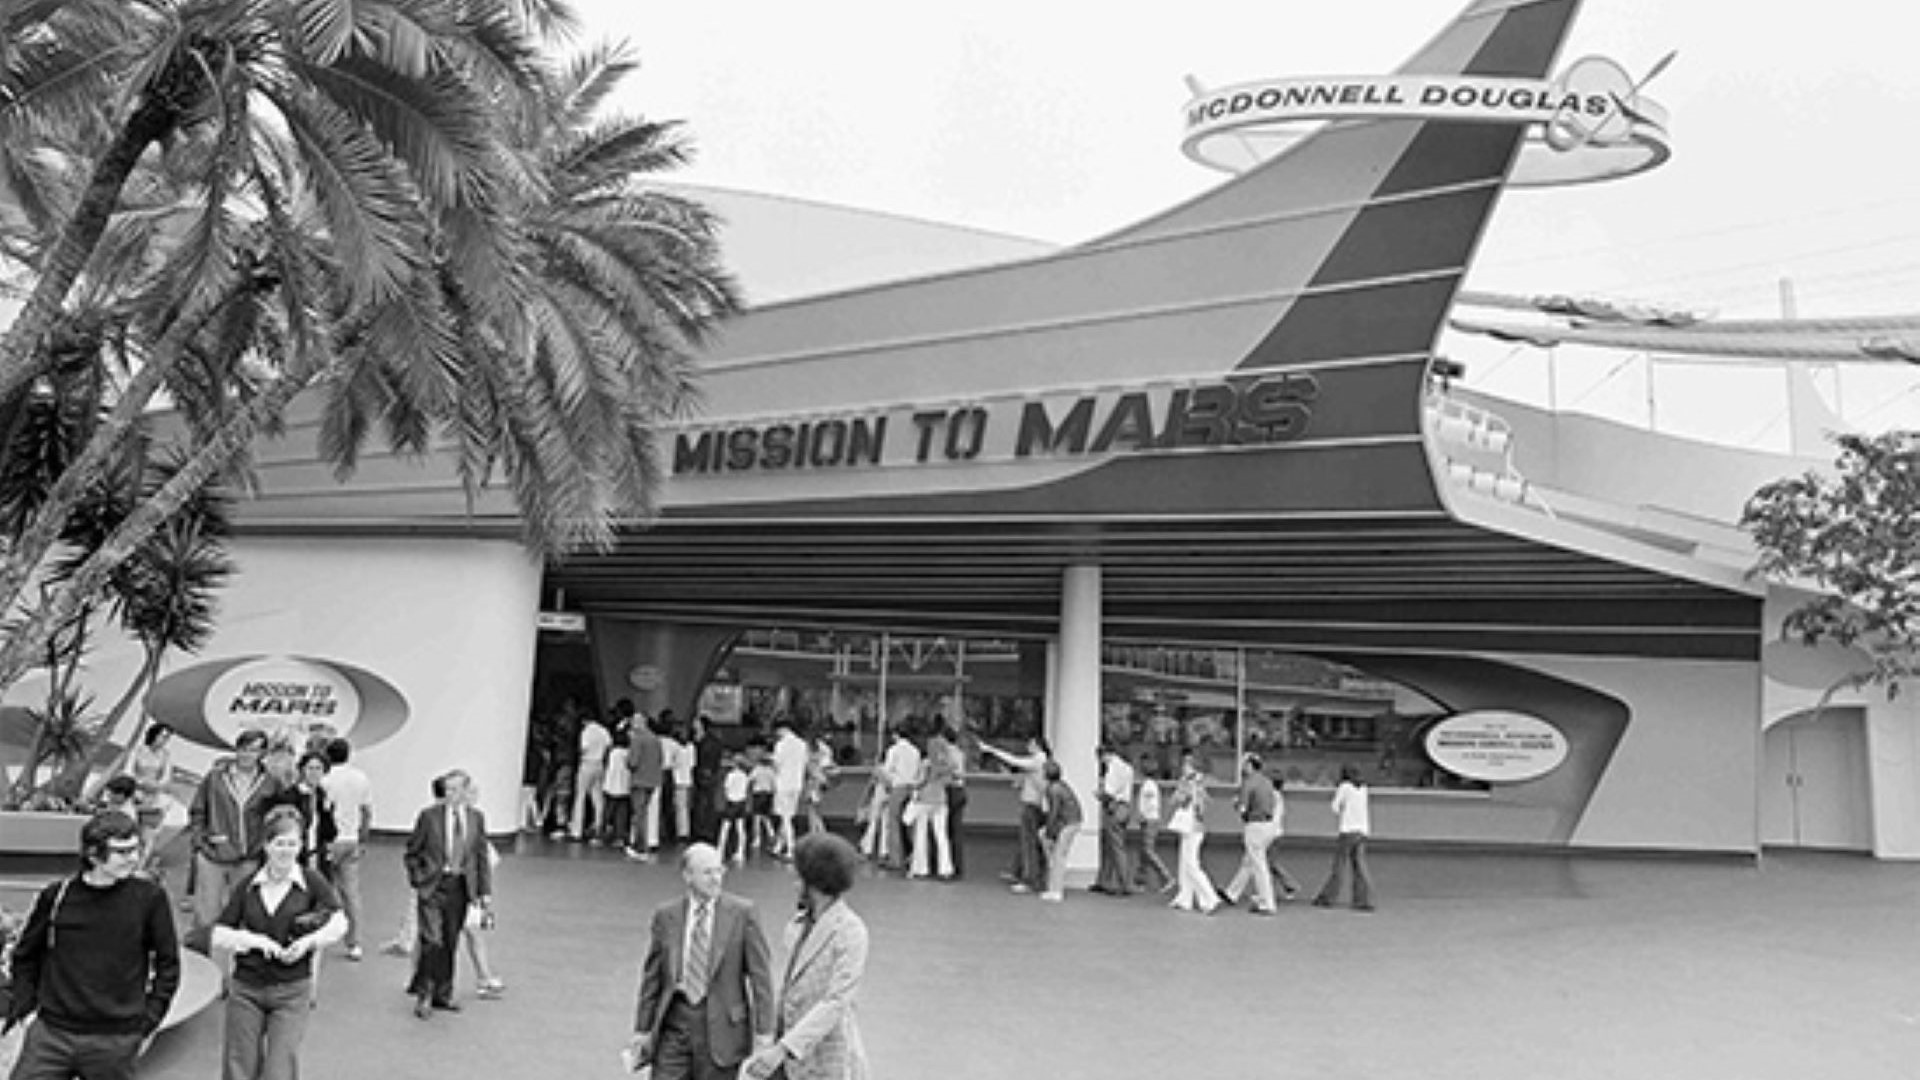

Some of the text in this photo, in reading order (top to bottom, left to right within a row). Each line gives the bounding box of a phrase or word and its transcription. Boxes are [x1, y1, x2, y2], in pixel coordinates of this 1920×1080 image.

[1188, 84, 1606, 126] MCDONNELL DOUGLAS
[673, 371, 1319, 474] MISSION TO MARS
[229, 698, 338, 714] MARS
